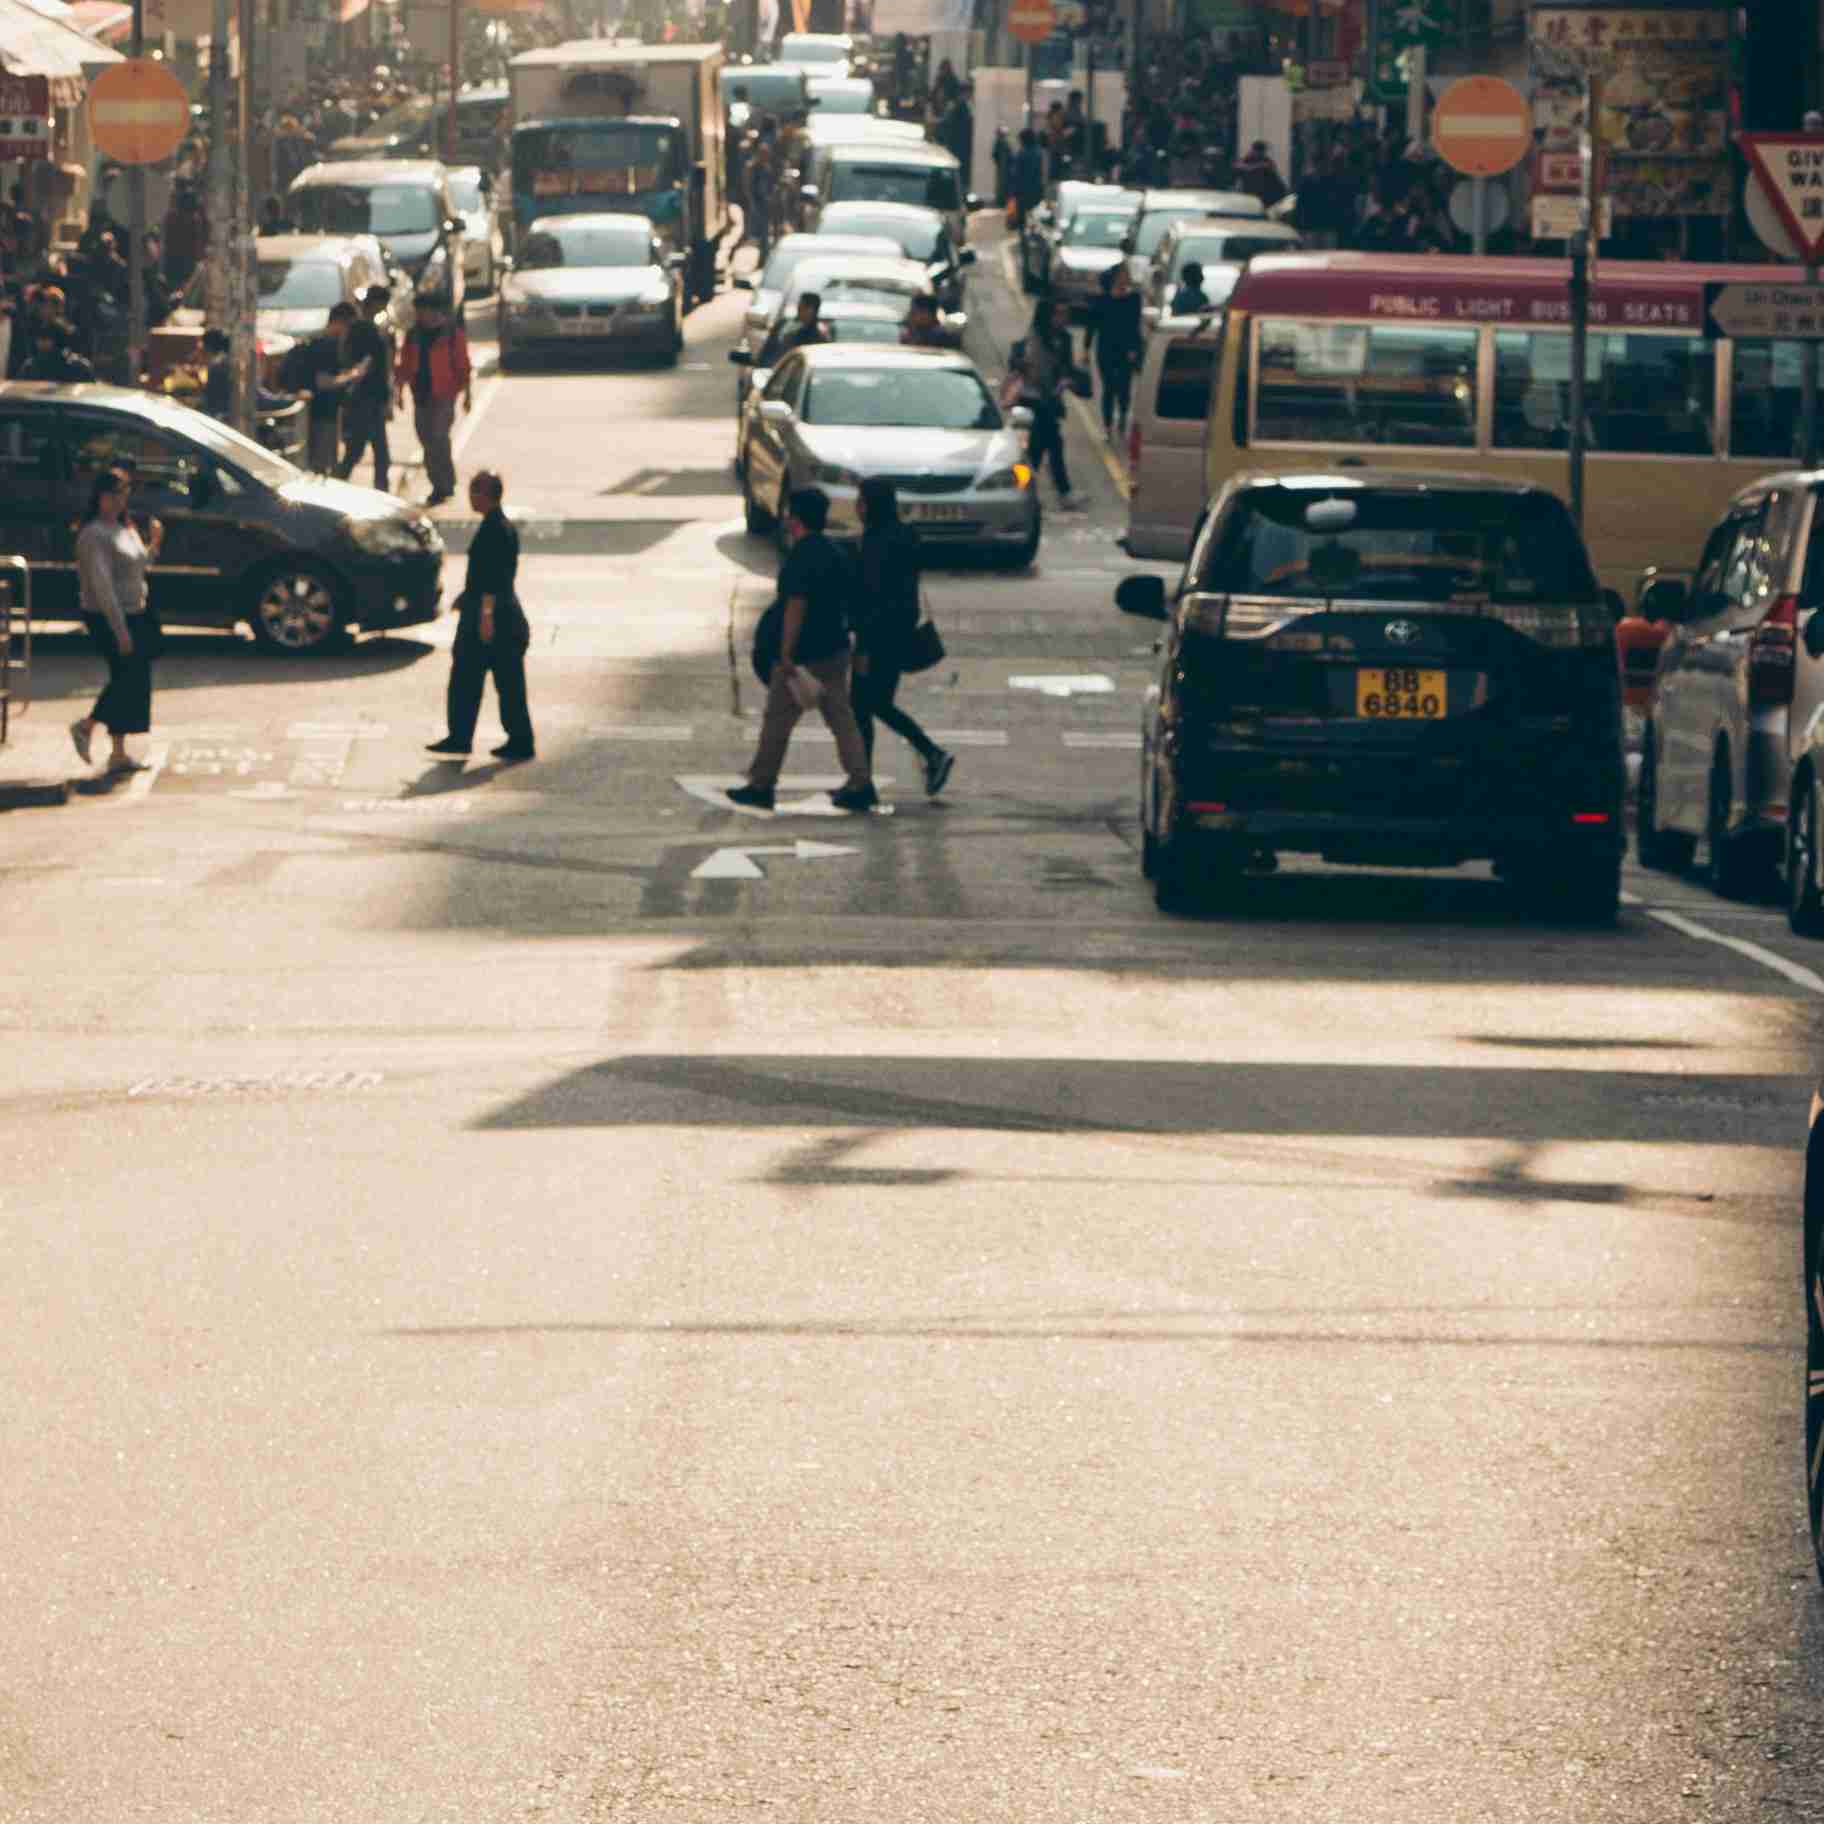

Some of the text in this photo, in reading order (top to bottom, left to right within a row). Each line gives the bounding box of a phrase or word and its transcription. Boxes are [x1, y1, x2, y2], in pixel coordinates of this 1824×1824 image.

[1369, 294, 1441, 316] PUBLIC
[1455, 297, 1513, 317] LIGHT
[1530, 299, 1572, 321] BUS
[1623, 303, 1689, 322] SEATS
[1364, 693, 1440, 718] 6840
